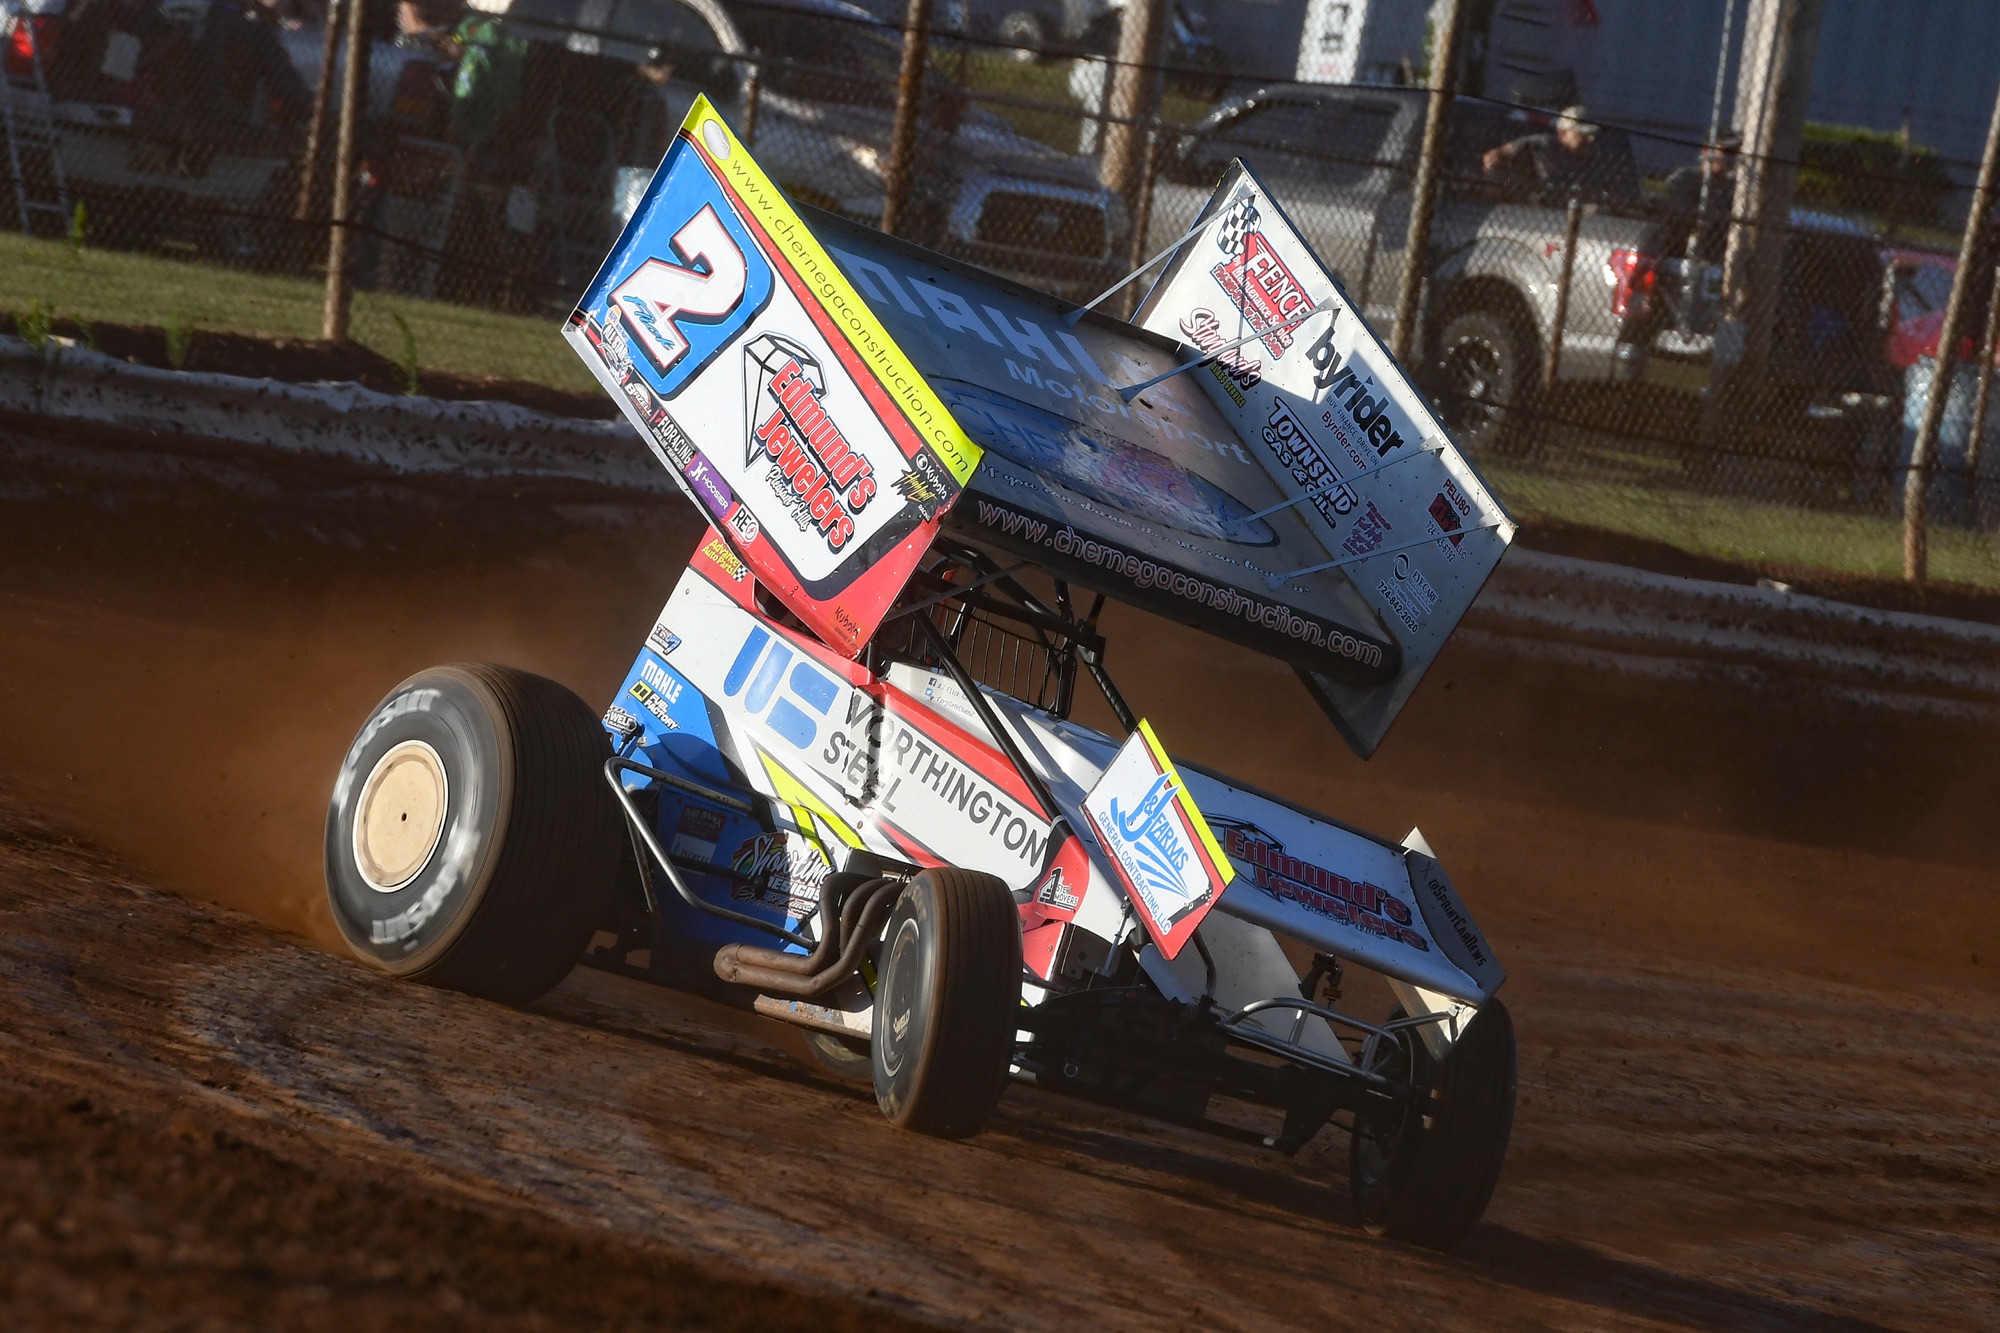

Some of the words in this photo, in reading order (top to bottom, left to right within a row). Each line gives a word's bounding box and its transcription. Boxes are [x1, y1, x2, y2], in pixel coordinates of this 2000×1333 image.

[611, 203, 747, 368] 2
[733, 160, 968, 473] www.chernegaconstruction.com
[1232, 266, 1272, 318] Maintenance
[1268, 314, 1293, 347] Sevice
[1247, 238, 1312, 326] FENCE
[1004, 357, 1251, 465] Motorsport
[1224, 381, 1247, 408] SERVICE
[1305, 326, 1404, 457] byrider
[657, 415, 692, 464] FLORACING
[768, 355, 877, 510] Edmund's
[1262, 426, 1293, 468] GAS
[1292, 468, 1308, 487] &
[1269, 396, 1359, 515] TOWNSEND
[1322, 411, 1367, 471] Byrider.com
[1356, 437, 1373, 457] DRIVE
[702, 474, 729, 510] HOOSIER
[755, 408, 855, 551] Jewelers
[926, 465, 947, 500] Kubota
[701, 545, 719, 562] Auto
[716, 556, 735, 576] Parts
[708, 538, 740, 567] Advance
[977, 500, 1382, 667] www.chernegaconstruction.com
[1378, 581, 1418, 633] 724-842-2020
[640, 658, 683, 704] MAHLE
[644, 699, 680, 730] FACTORY
[650, 693, 669, 713] FUEL
[823, 731, 902, 813] STEL
[845, 691, 1049, 868] WORTHINGTON
[733, 834, 837, 887] Showtime
[1098, 810, 1122, 857] GENERAL
[1121, 850, 1159, 919] CONTRACTING,
[1156, 911, 1172, 934] LLC
[1151, 812, 1189, 872] FARMS
[1224, 826, 1412, 926] Edmund's
[1253, 864, 1430, 951] Jewelers
